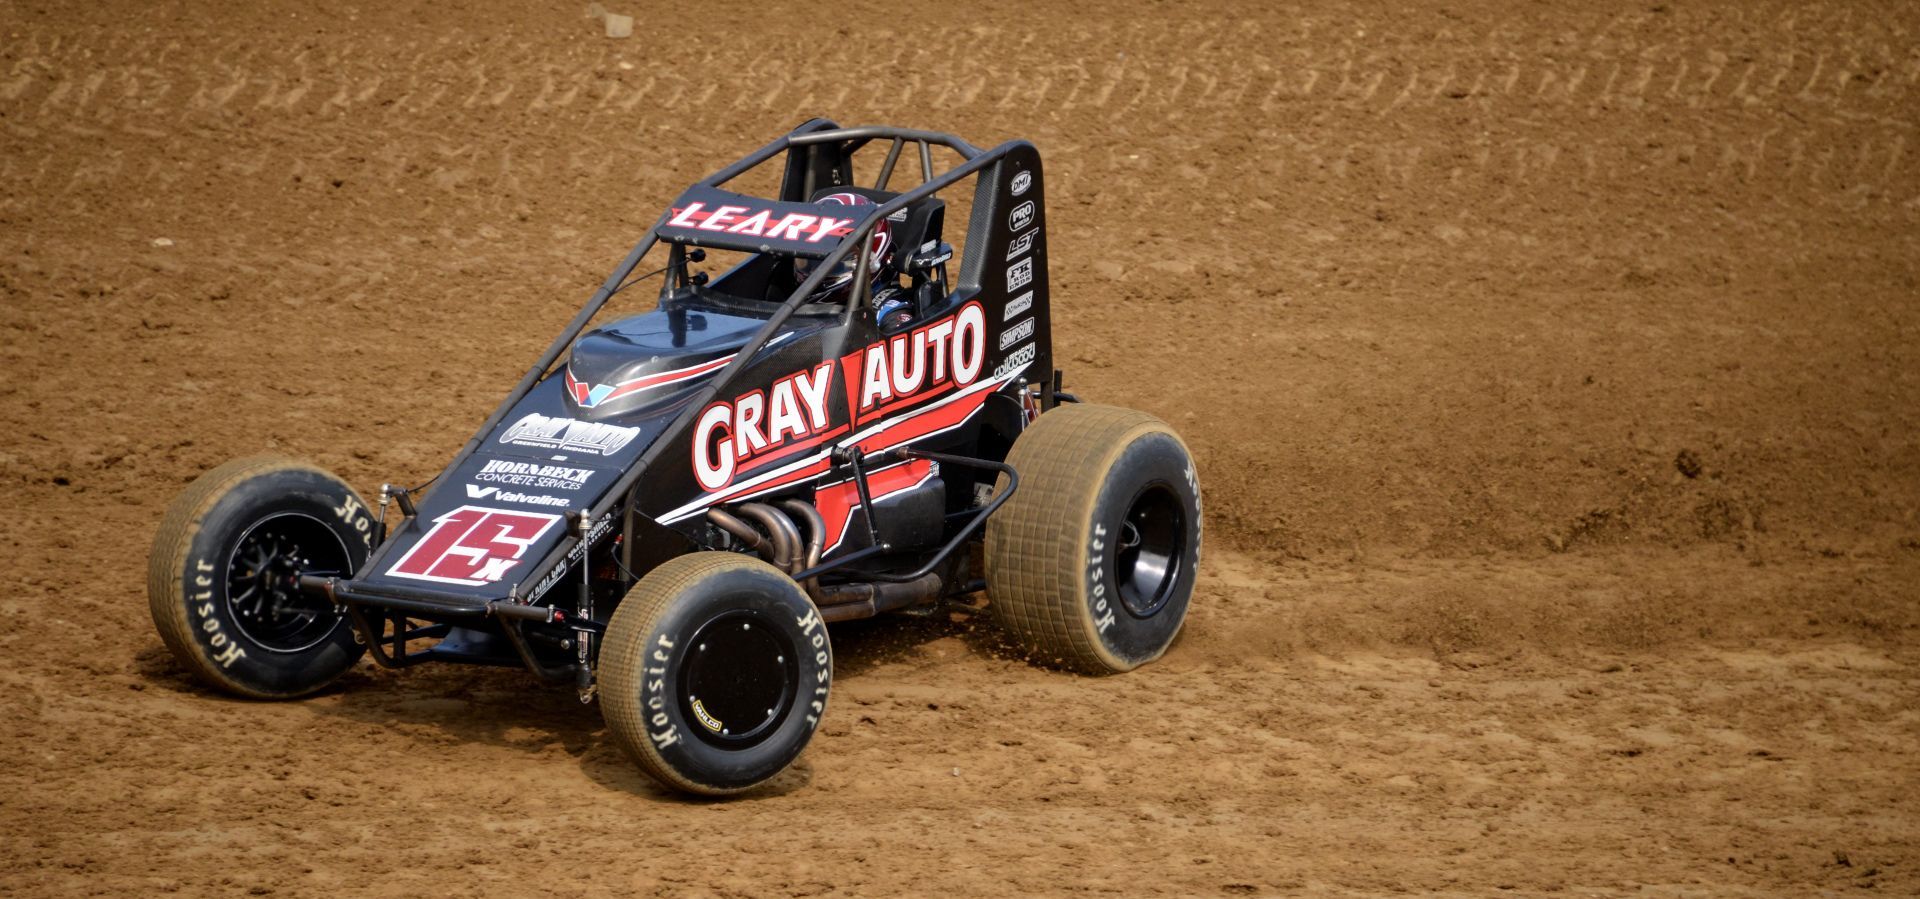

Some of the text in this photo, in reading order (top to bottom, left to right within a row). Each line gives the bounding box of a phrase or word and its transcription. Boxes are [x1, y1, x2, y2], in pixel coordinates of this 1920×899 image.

[1013, 176, 1029, 192] DMI
[667, 202, 850, 243] LEARY
[1012, 204, 1032, 223] PRO
[1008, 227, 1040, 257] LST
[1002, 320, 1033, 347] SIMPSON
[693, 303, 986, 489] GRAY AUTO
[512, 440, 599, 455] GREENFIELD INDIANA
[475, 473, 582, 490] CONCRETE SERVICES
[480, 459, 596, 484] HORNBECK
[1088, 524, 1116, 634] Hoosier
[189, 558, 247, 668] Hoosier
[796, 608, 829, 730] Hoosier
[644, 633, 678, 749] Hoosier
[694, 702, 720, 730] VAHLCO
